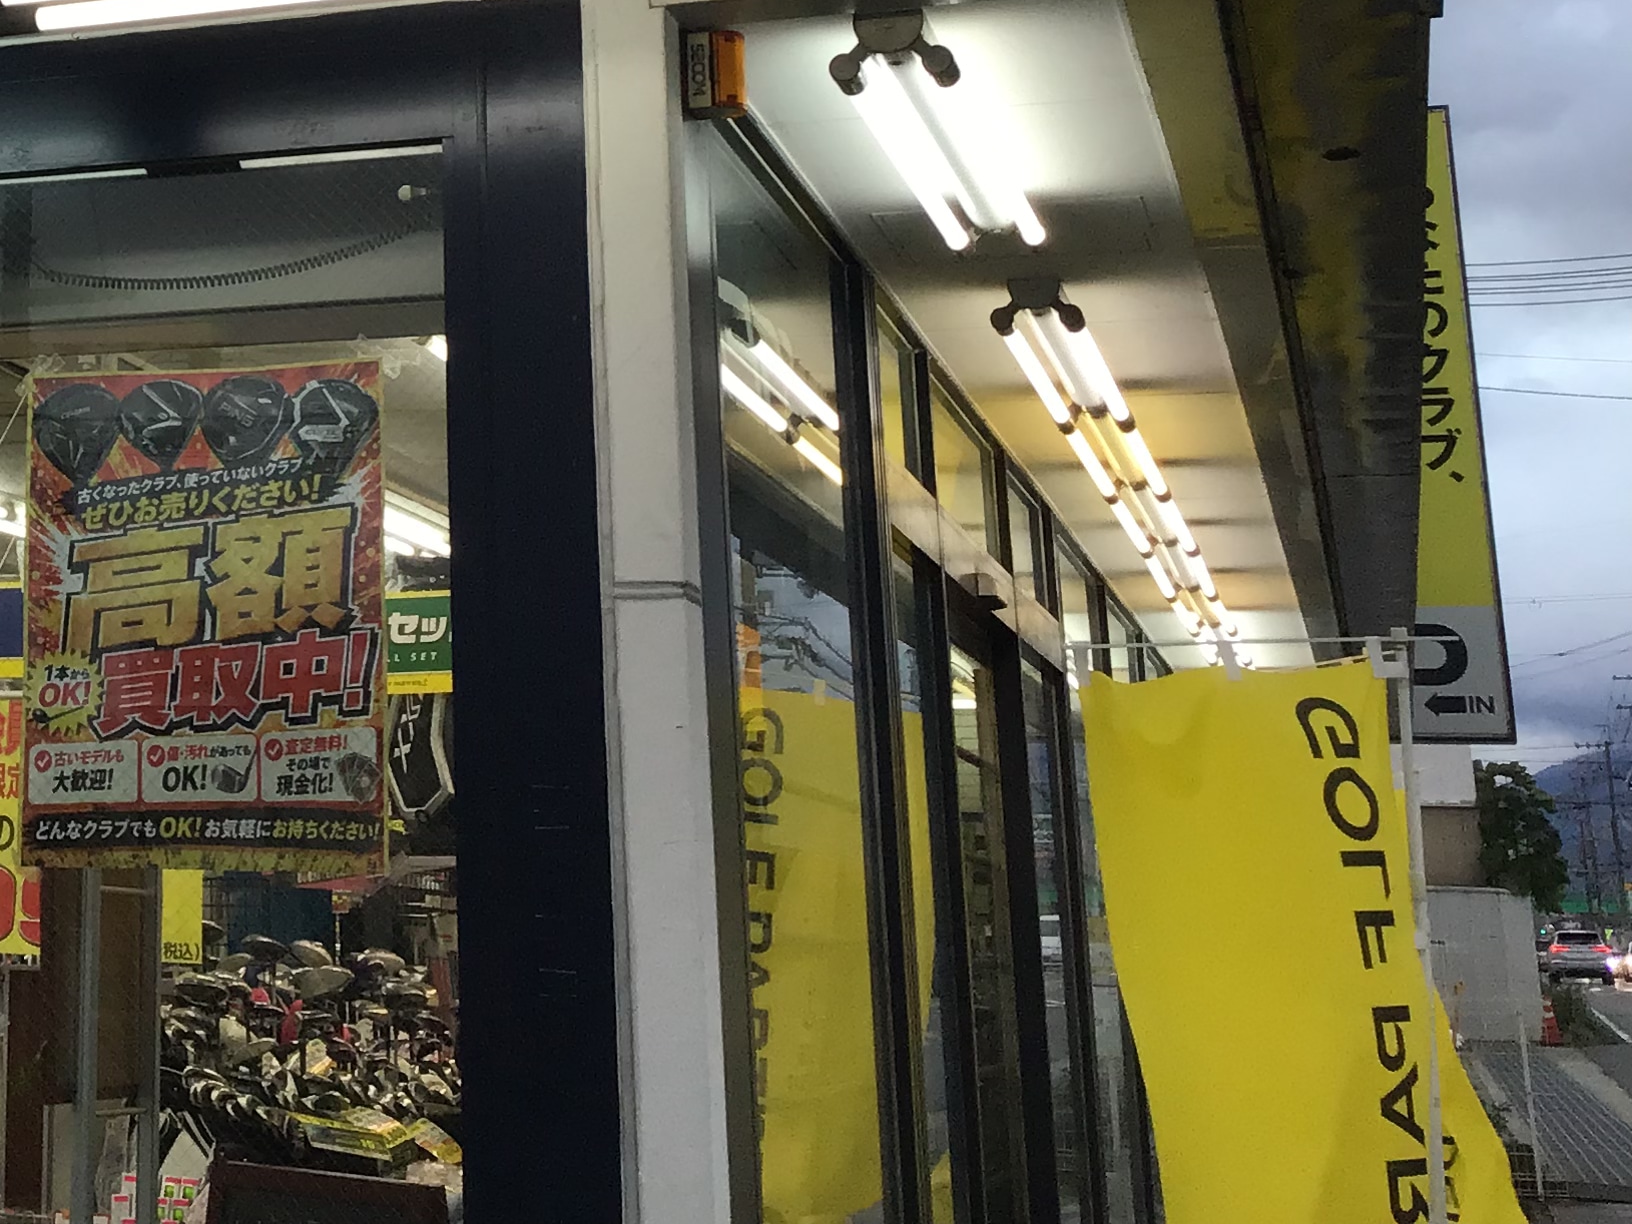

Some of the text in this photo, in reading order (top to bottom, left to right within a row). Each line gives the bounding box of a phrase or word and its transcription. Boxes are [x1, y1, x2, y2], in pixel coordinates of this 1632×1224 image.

[71, 507, 350, 650] 高額
[387, 612, 452, 645] セッ
[410, 651, 438, 662] SET
[38, 682, 91, 708] OK!
[93, 630, 369, 737] 買取中!
[1468, 695, 1496, 715] IN
[162, 765, 208, 793] OK!
